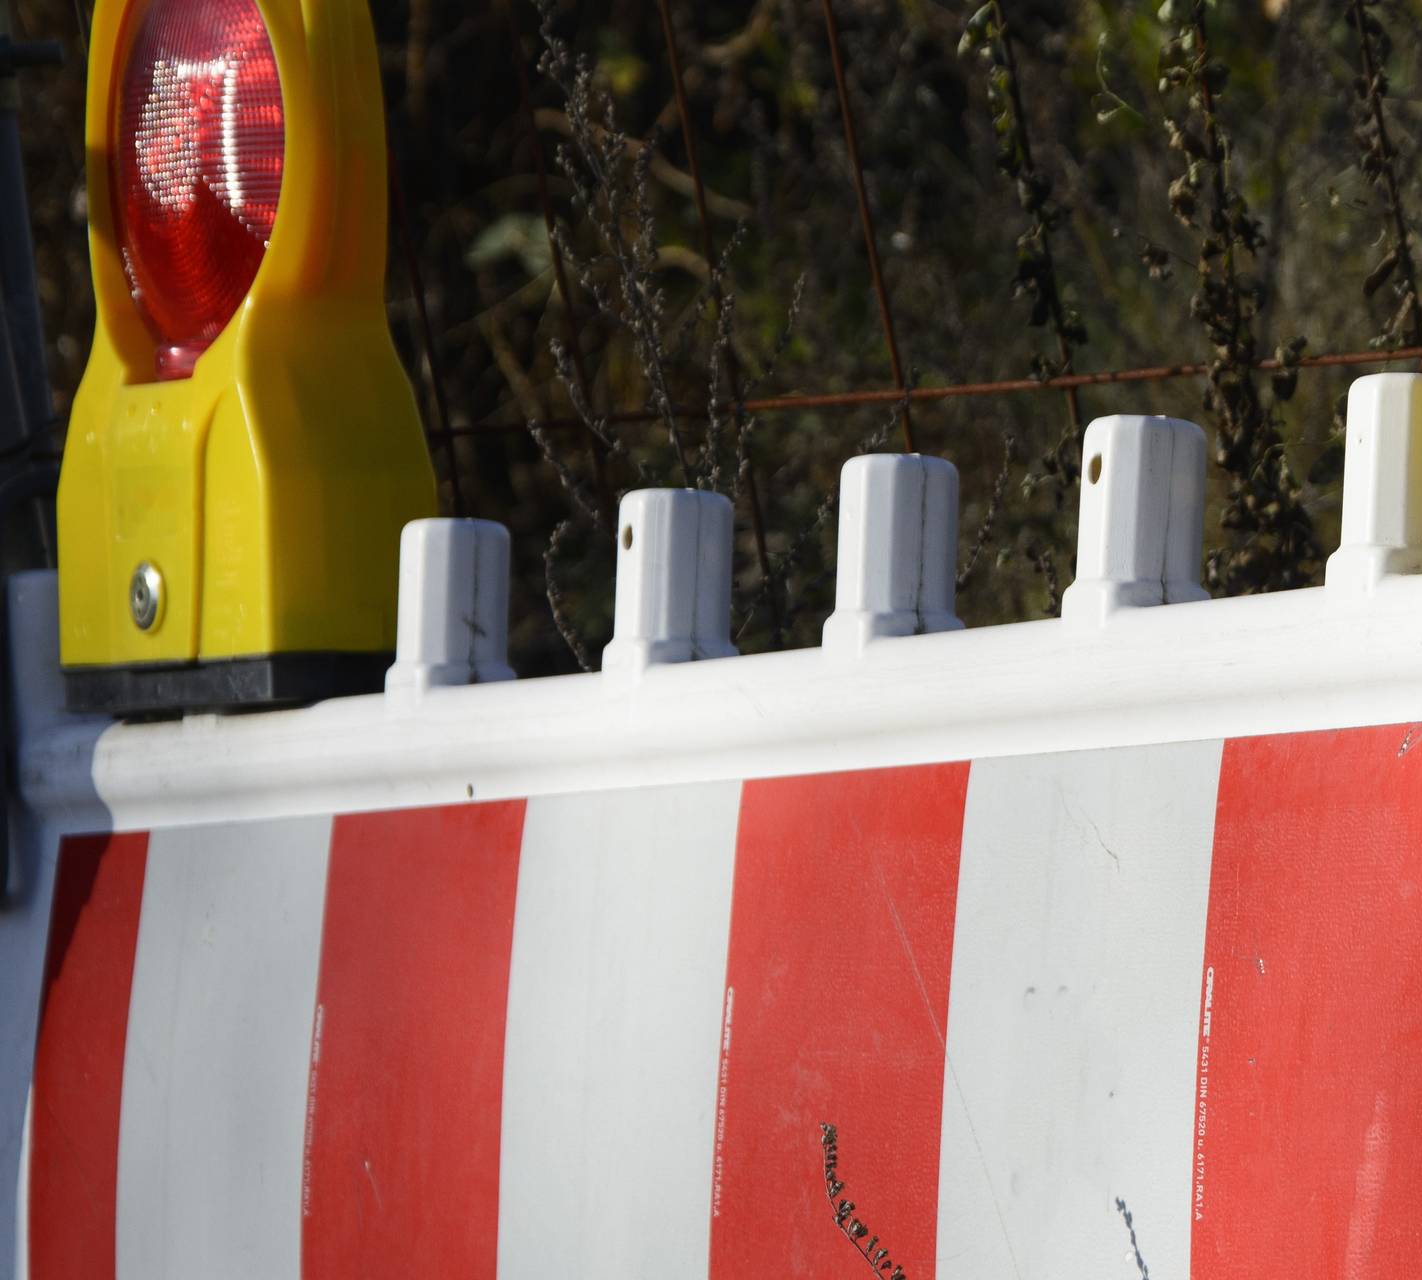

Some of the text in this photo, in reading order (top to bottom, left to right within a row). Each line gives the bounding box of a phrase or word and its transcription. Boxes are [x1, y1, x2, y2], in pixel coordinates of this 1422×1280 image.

[1203, 966, 1214, 1037] ORALITE
[1200, 1046, 1209, 1073] 5431
[1199, 1076, 1207, 1098] DIN
[1198, 1101, 1207, 1136] 67520
